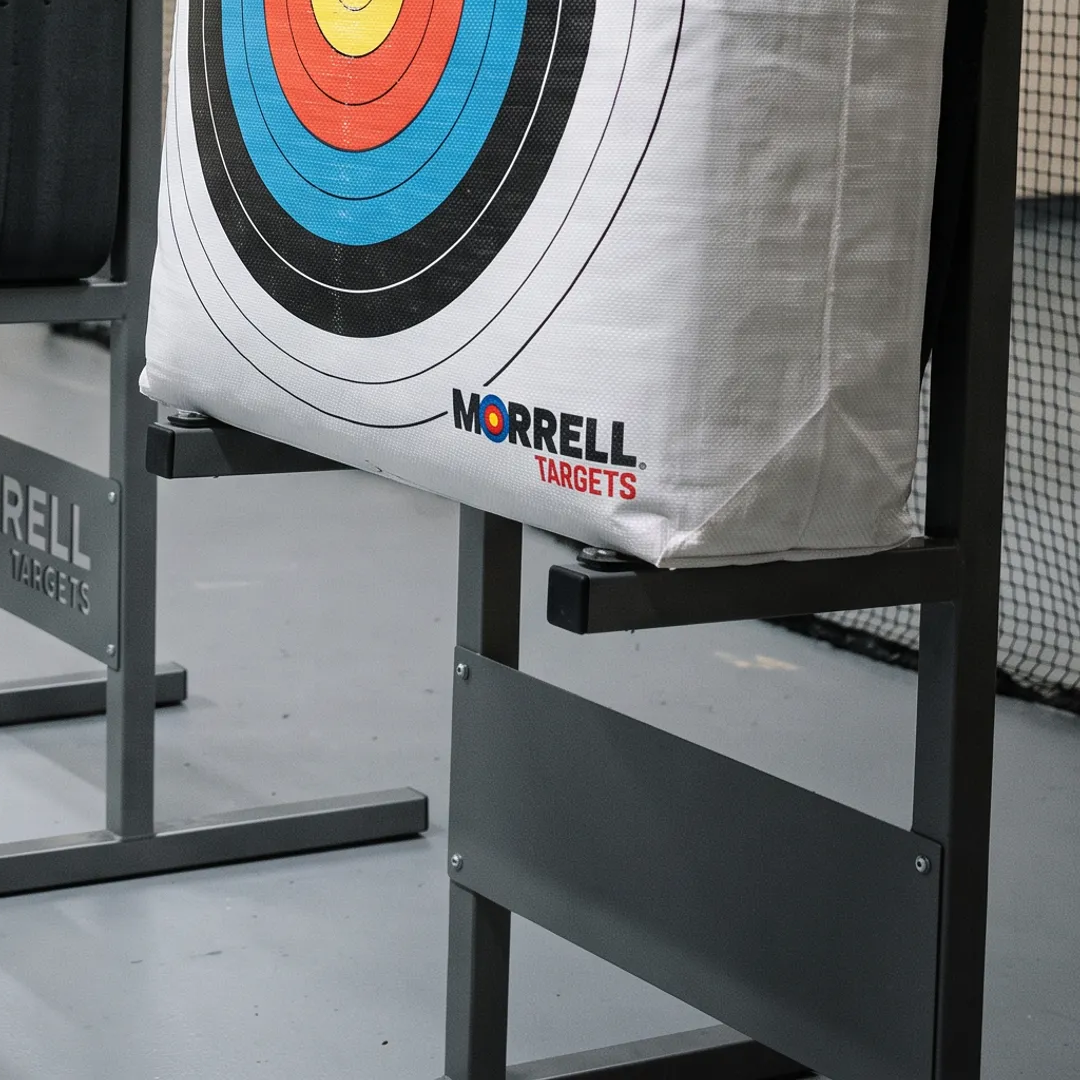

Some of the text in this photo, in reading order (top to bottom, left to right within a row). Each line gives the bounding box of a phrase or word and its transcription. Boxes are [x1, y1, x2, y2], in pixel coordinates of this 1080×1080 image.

[452, 387, 637, 468] MORRELL
[534, 454, 637, 500] TARGETS
[10, 547, 91, 616] TARGETS
